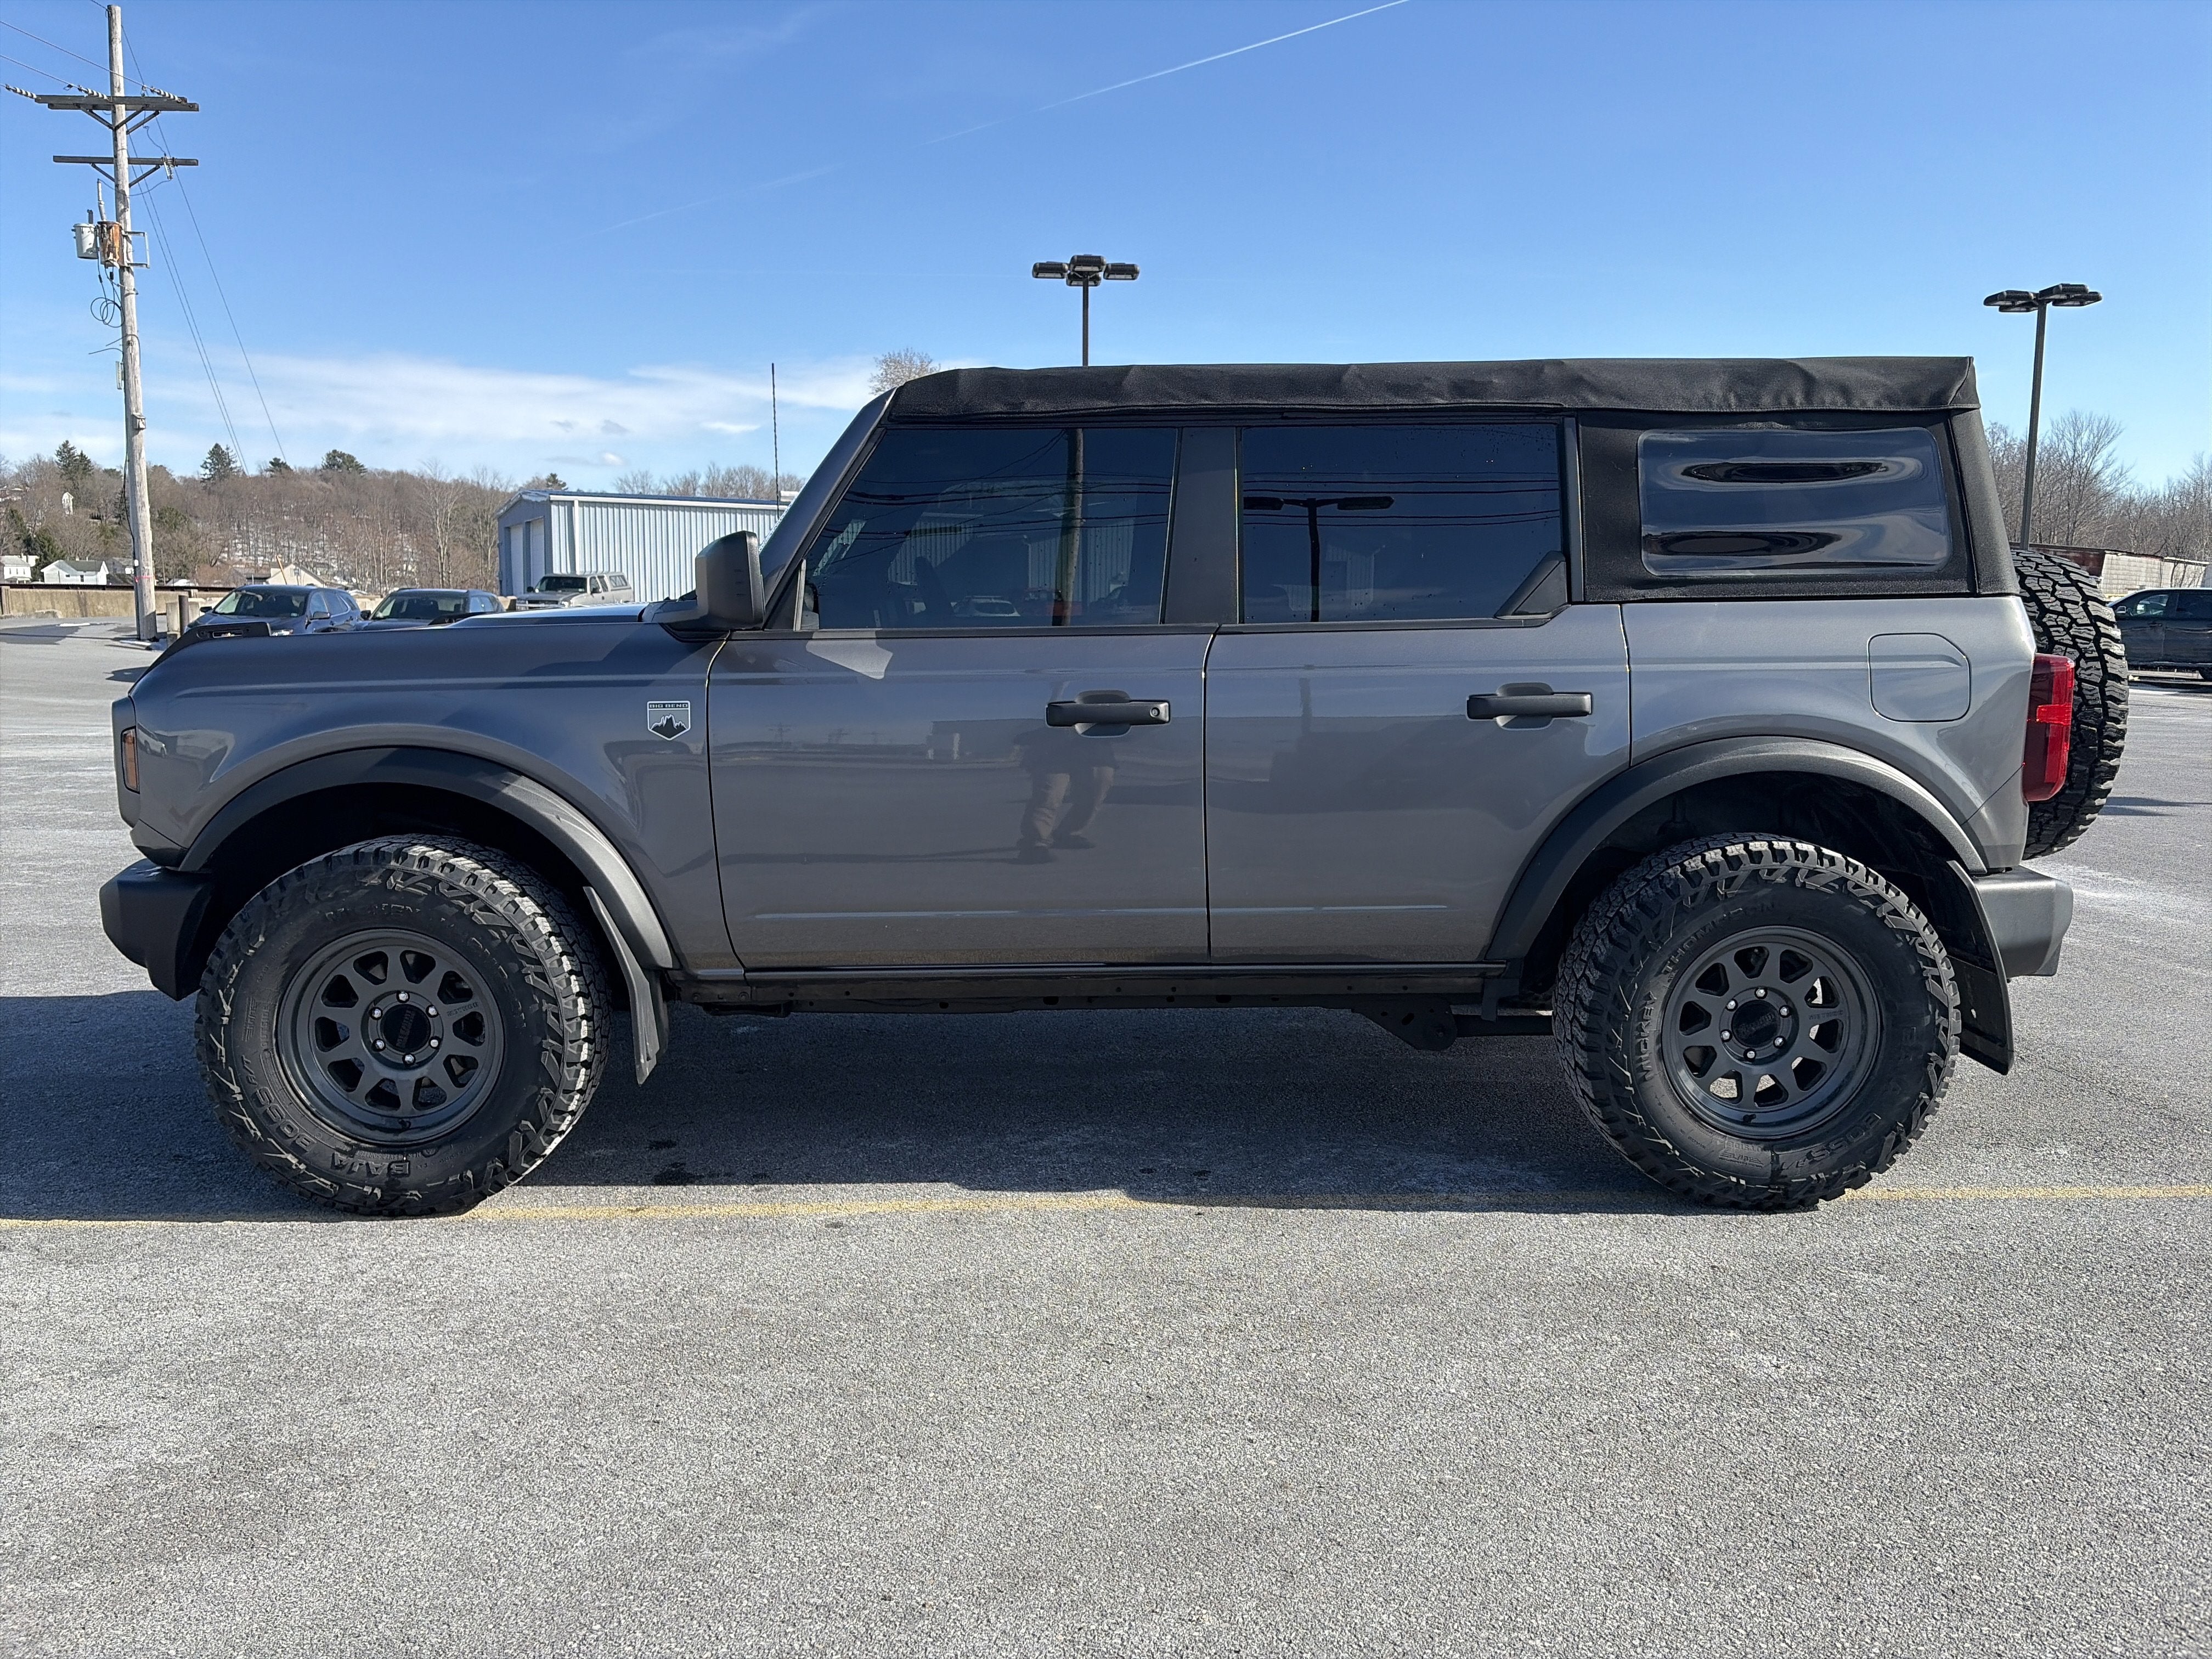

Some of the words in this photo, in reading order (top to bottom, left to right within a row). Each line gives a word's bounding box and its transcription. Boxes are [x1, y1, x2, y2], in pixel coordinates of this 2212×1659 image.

[1638, 991, 1657, 1081] MICKEY
[241, 1054, 258, 1086] A/T
[255, 1086, 318, 1153] BOSS
[331, 1152, 410, 1177] BAJA
